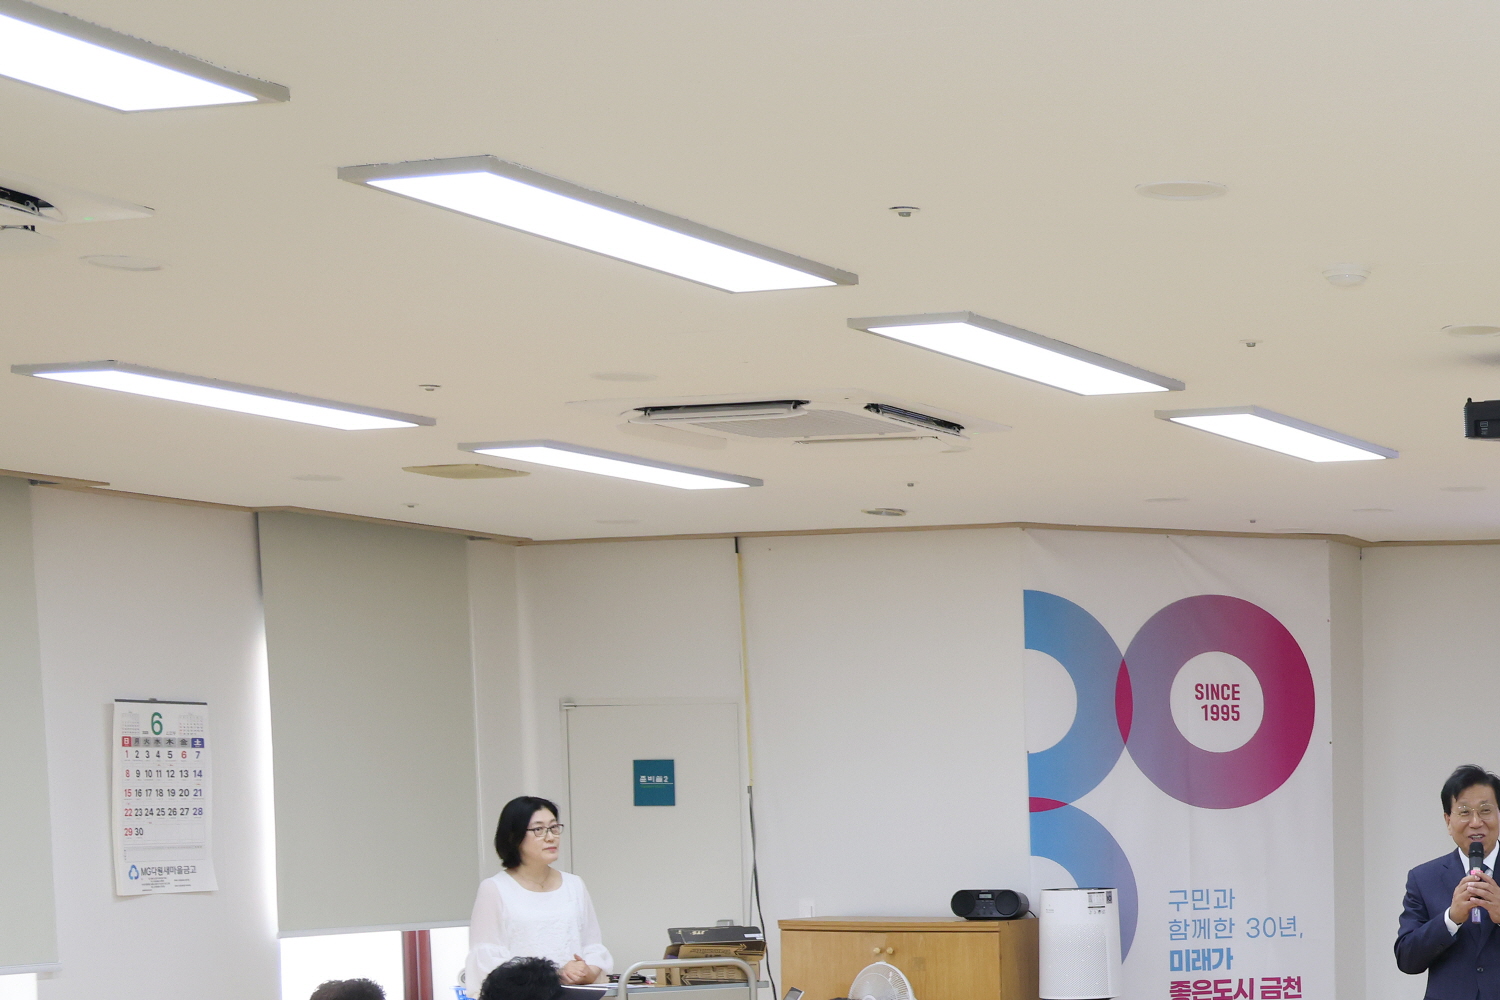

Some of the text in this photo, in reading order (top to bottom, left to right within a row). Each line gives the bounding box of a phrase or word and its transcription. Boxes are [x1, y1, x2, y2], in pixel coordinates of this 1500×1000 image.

[1194, 683, 1241, 701] SINCE
[1201, 703, 1241, 722] 1995
[151, 712, 163, 735] 6
[124, 789, 202, 797] 15 16 17 18 19 20 21
[135, 808, 143, 816] 23
[144, 808, 154, 816] 24
[156, 808, 165, 816] 25
[168, 808, 177, 816] 26
[180, 808, 189, 816] 27
[193, 808, 203, 816] 28
[124, 828, 133, 836] 29
[1168, 888, 1236, 912] 구민과
[1168, 915, 1303, 941] 함께한 30년,
[1169, 947, 1234, 972] 미래가
[1260, 976, 1302, 1000] 금천
